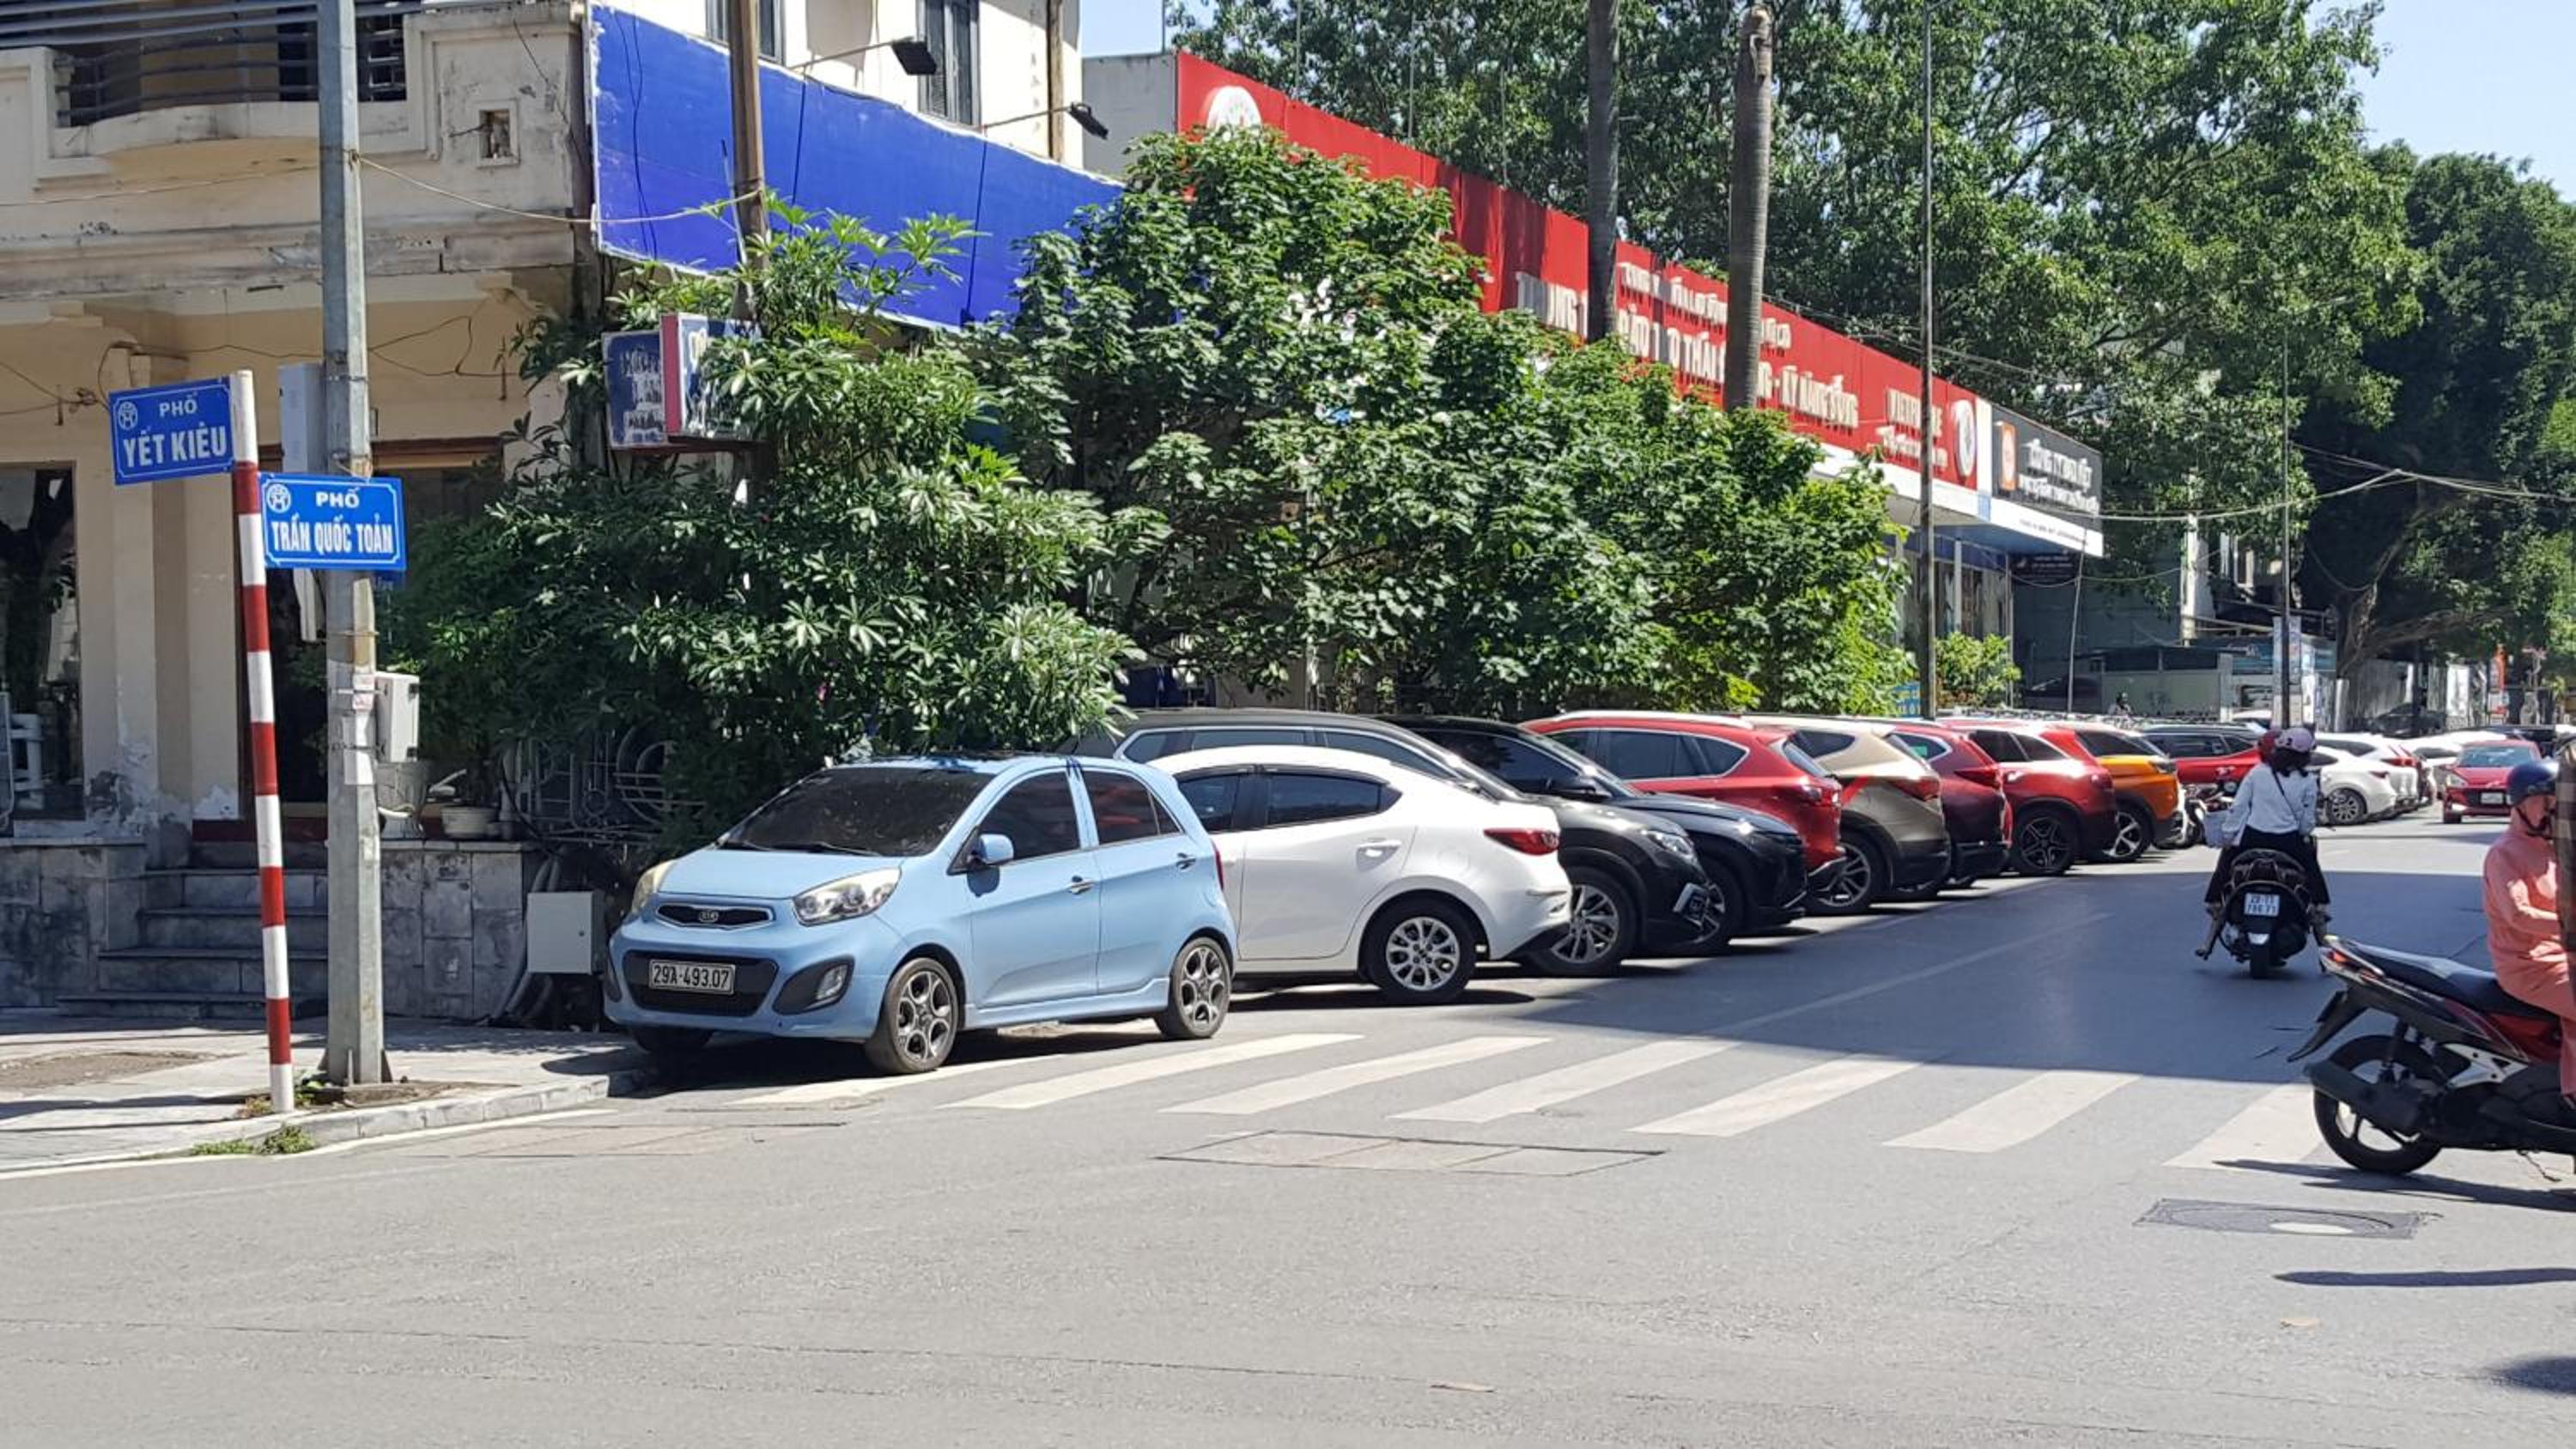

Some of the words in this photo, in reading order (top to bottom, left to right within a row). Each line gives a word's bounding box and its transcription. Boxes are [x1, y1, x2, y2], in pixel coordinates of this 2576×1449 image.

[159, 391, 197, 417] PHỐ
[123, 426, 165, 467] YẾT
[171, 421, 227, 462] KIÊU
[316, 487, 361, 508] PHỐ
[314, 513, 352, 555] QUỐC
[355, 512, 393, 553] TOẢN
[653, 964, 729, 988] 29A-493.07
